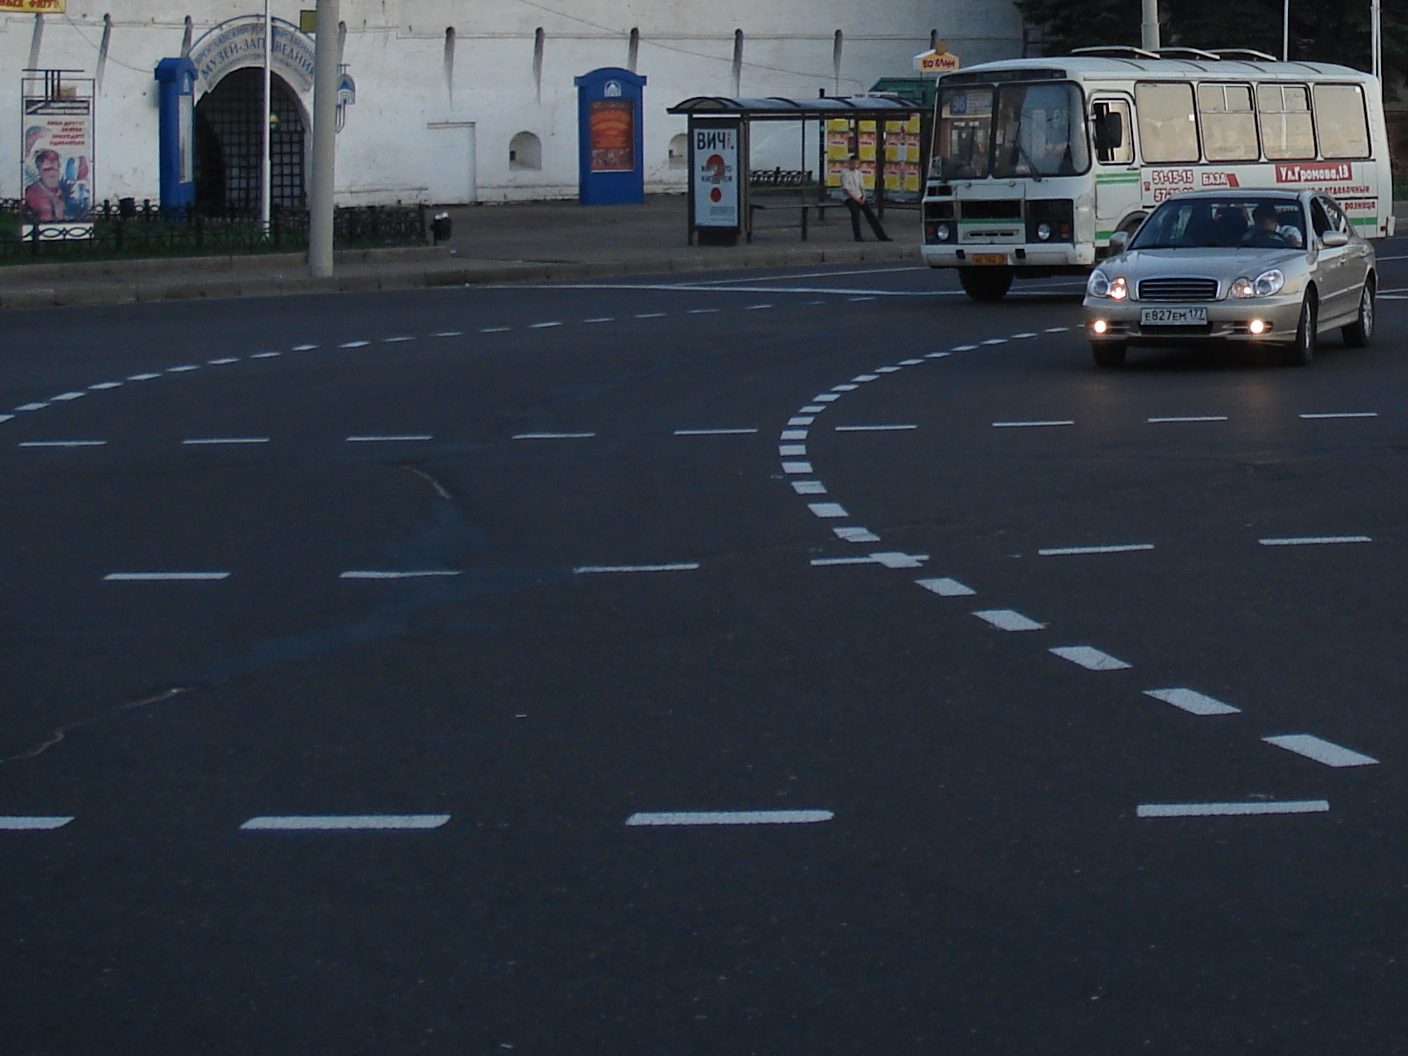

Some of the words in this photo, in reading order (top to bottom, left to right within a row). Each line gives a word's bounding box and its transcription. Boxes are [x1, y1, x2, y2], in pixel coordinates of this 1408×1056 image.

[697, 132, 726, 150] ВИЧ
[1152, 170, 1194, 185] 51-15-15
[1202, 172, 1228, 186] БАЗА
